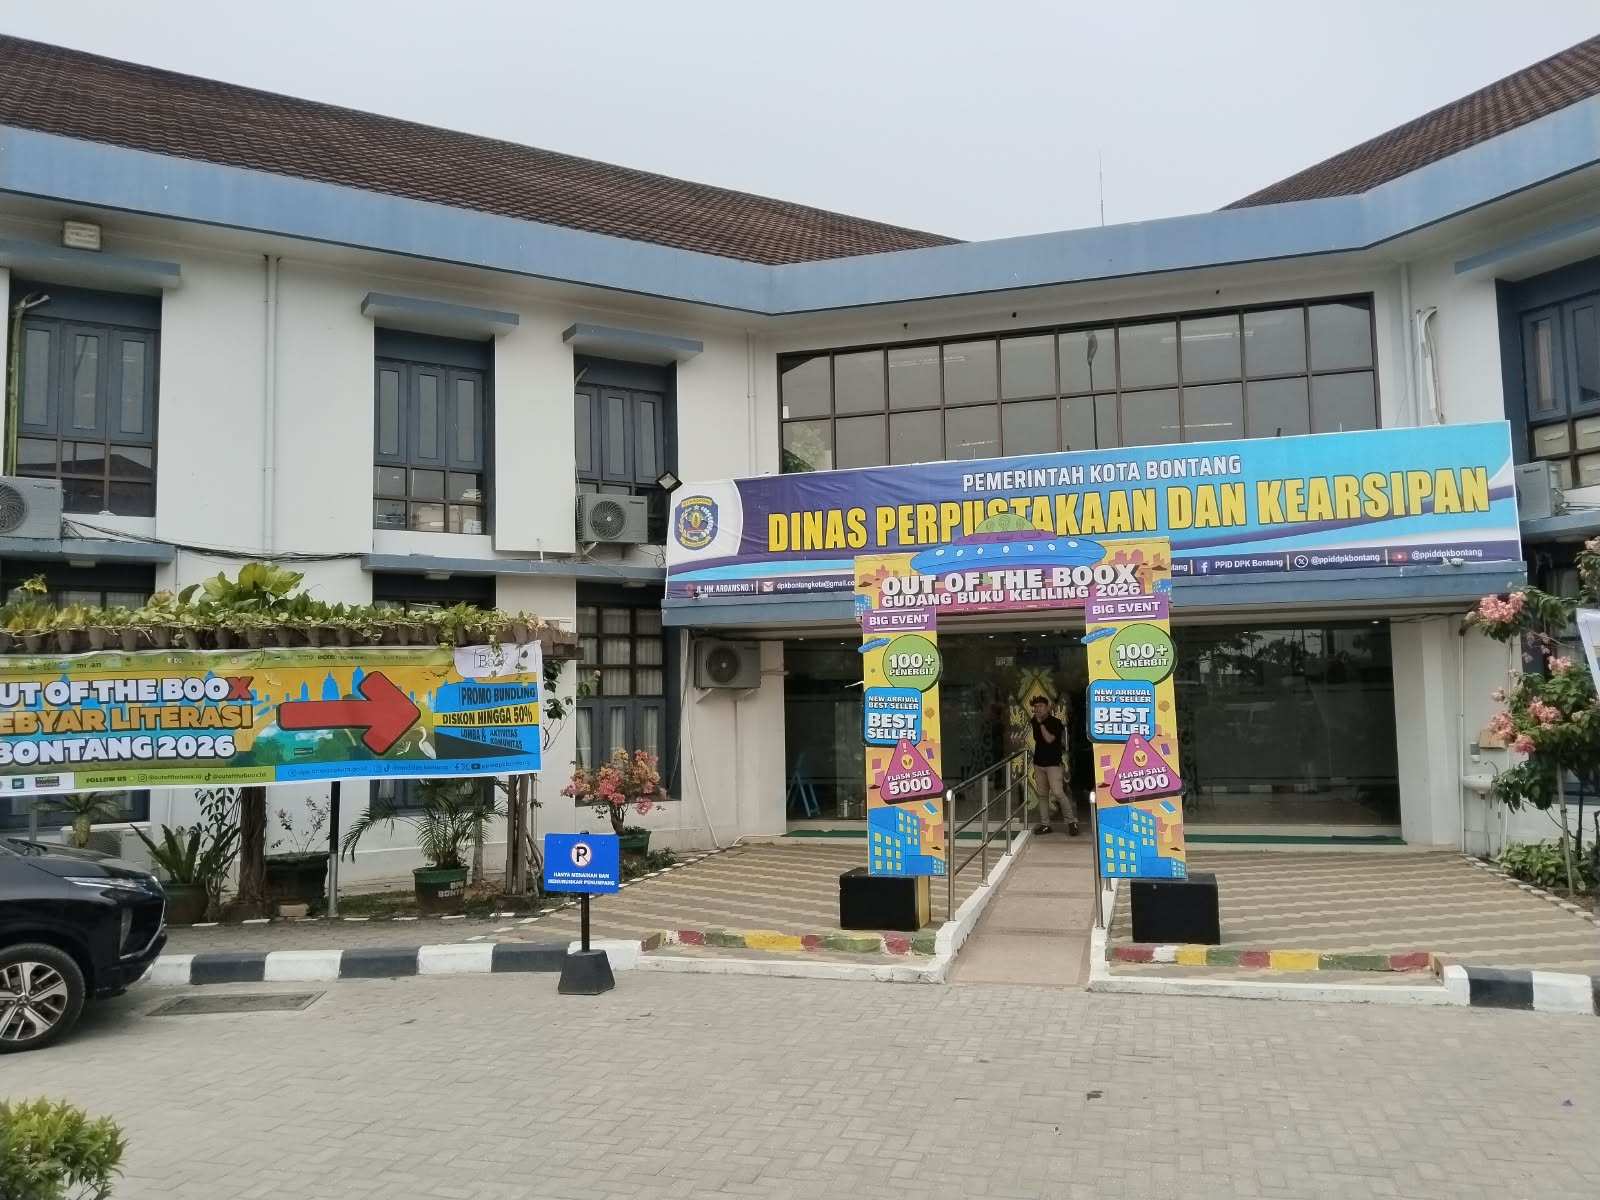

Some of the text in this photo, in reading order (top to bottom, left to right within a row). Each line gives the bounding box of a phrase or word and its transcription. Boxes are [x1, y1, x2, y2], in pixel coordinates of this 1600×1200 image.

[962, 455, 1242, 493] PEMERINTAH KOTA BONTANG
[767, 508, 868, 553] DINAS
[1166, 481, 1246, 530] DAN
[1256, 466, 1491, 525] KEARSIPAN
[1310, 553, 1381, 566] @ppiddpkbontang
[1411, 549, 1483, 560] @ppiddpkbontang
[1215, 559, 1284, 569] PPID DPK Bontang
[881, 563, 1137, 596] OUT OF THE BOOX
[881, 582, 1141, 608] GUDANG BUKU KELILING 2026
[1092, 601, 1161, 615] BIG EVENT
[869, 614, 930, 626] BIG EVENT
[1116, 642, 1169, 660] 100+
[889, 652, 935, 668] 100+
[1116, 658, 1169, 668] PENERBIT
[889, 667, 936, 676] PENERBIT
[44, 680, 90, 707] OF
[90, 678, 158, 705] THE
[162, 675, 254, 703] BOOX
[461, 686, 536, 706] PROMO BUNDLING
[887, 695, 919, 703] ARRIVAL
[890, 702, 919, 710] SELLER
[1094, 695, 1117, 703] BEST
[110, 703, 254, 732] LITERASI
[442, 704, 533, 725] DISKON HINGGA 50%
[868, 712, 918, 729] BEST
[1094, 707, 1150, 723] BEST
[867, 727, 917, 740] SELLER
[1094, 722, 1150, 736] SELLER
[156, 735, 237, 760] 2026
[86, 775, 127, 784] FOLLOW US
[887, 769, 931, 781] FLASH SALE
[1118, 765, 1168, 780] FLASH SALE
[888, 776, 933, 795] 5000
[1119, 773, 1169, 794] 5000
